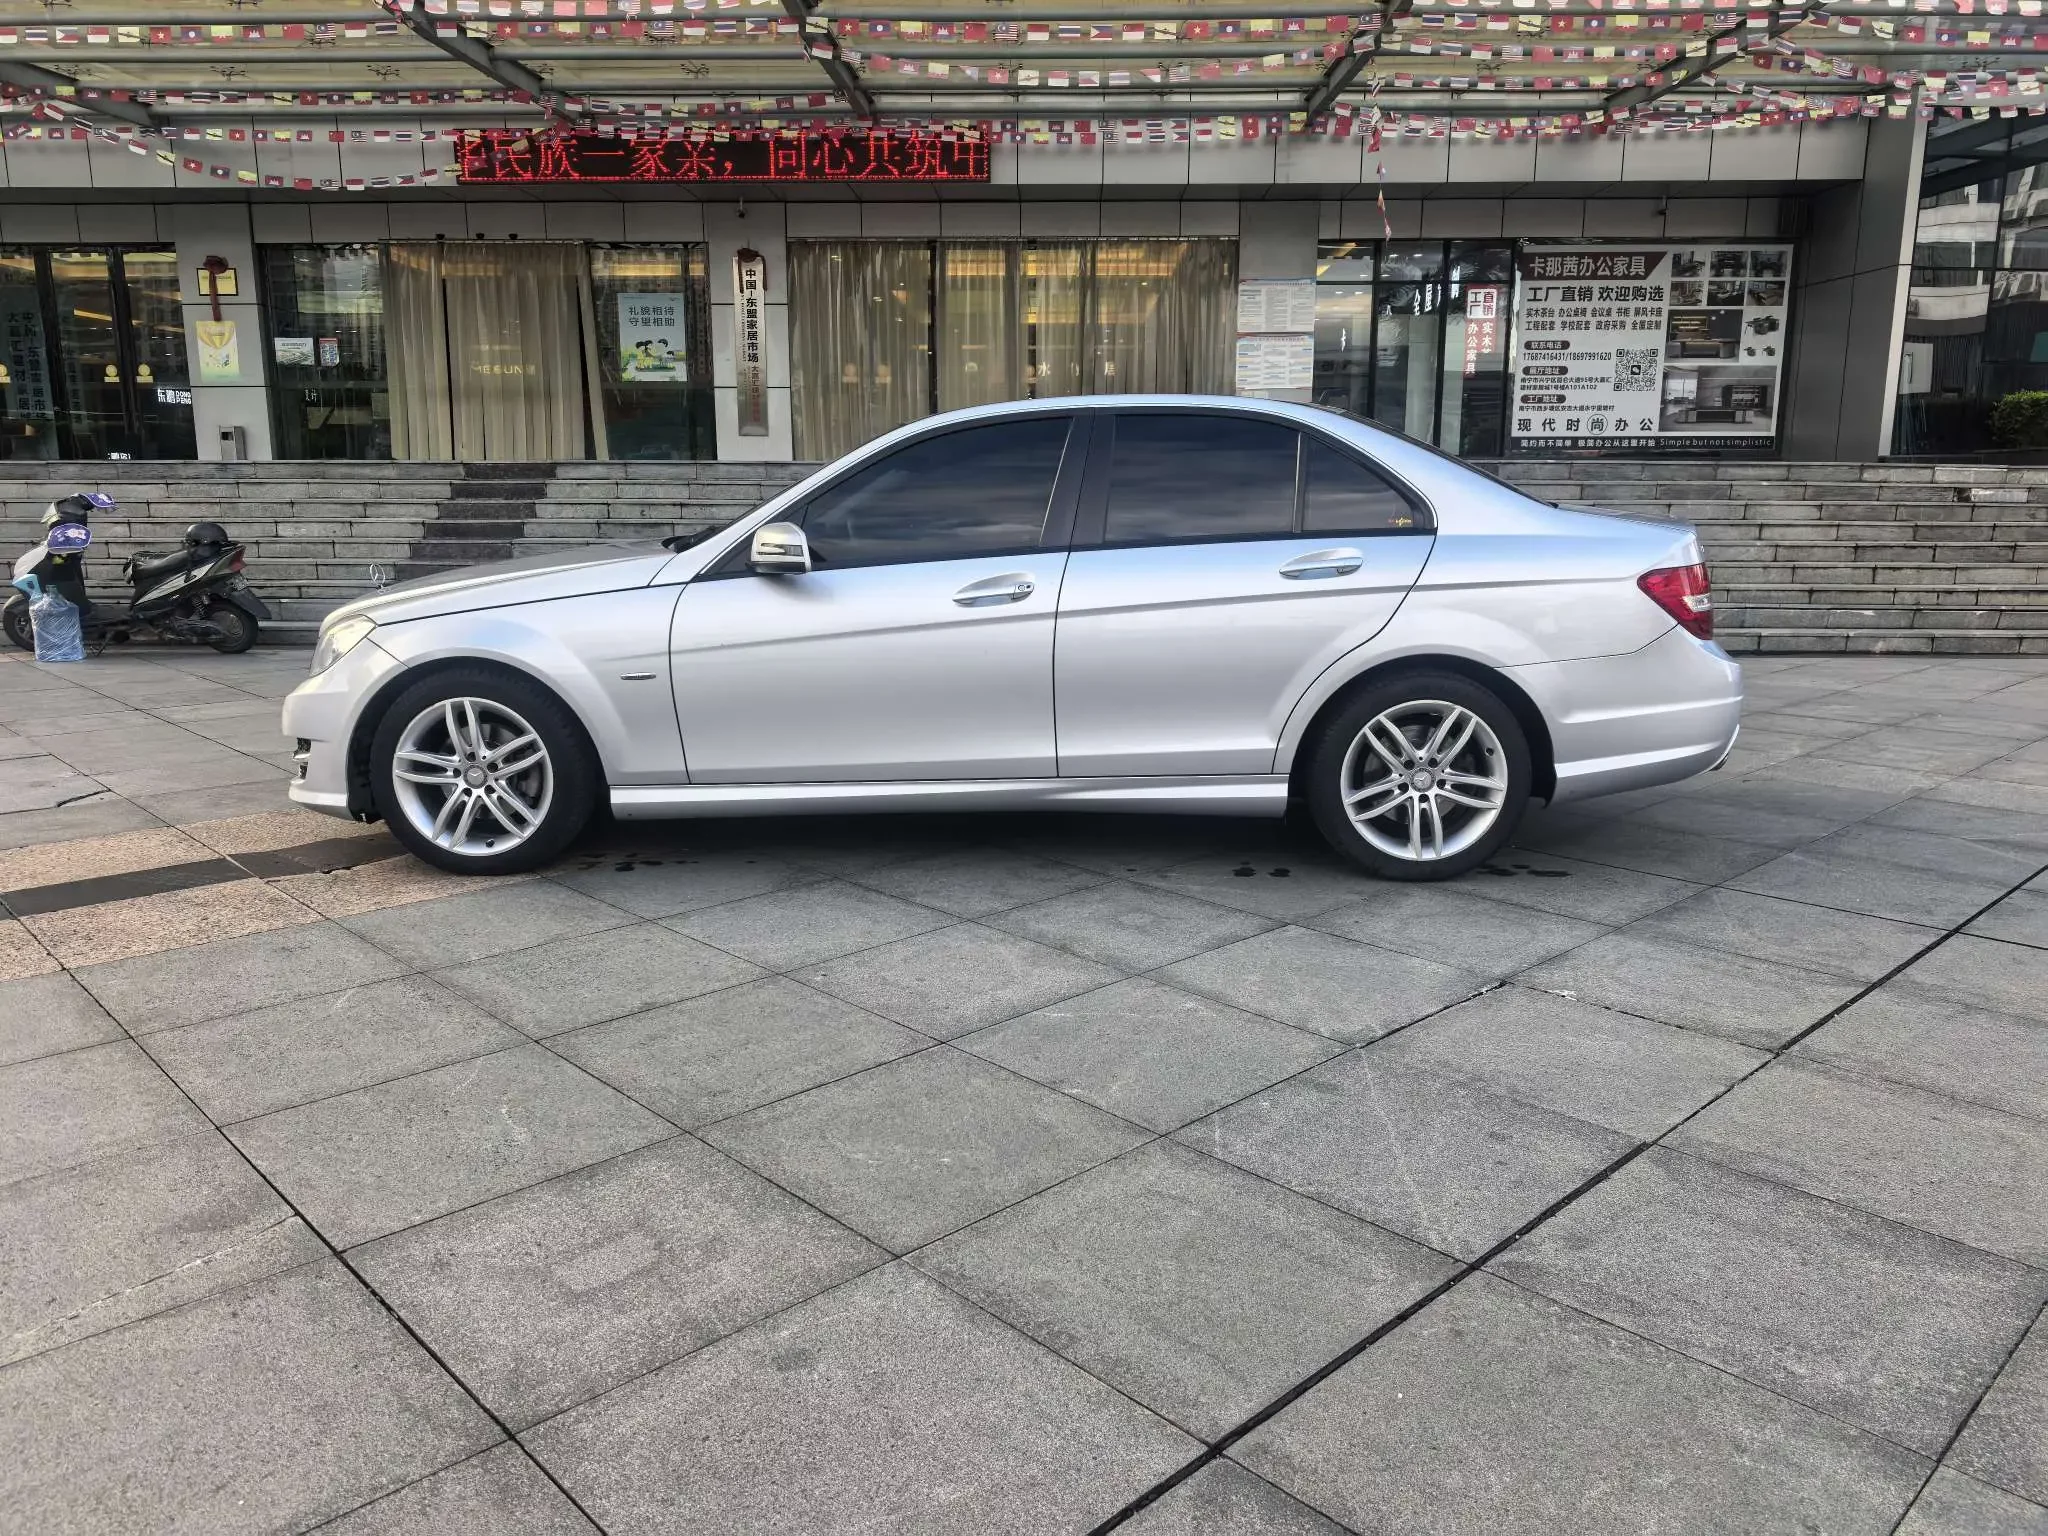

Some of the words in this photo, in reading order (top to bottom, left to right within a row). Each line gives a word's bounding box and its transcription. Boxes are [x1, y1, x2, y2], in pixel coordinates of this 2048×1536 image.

[1529, 255, 1646, 277] 卡那茜办公家具
[1526, 285, 1594, 302] 工厂直销
[1597, 285, 1665, 302] 欢迎购选
[628, 305, 675, 316] 礼貌相待
[1558, 307, 1587, 318] 办公桌椅
[1591, 307, 1612, 318] 会议桌
[628, 317, 675, 327] 守望相助
[1525, 321, 1556, 331] 工程配套
[1560, 321, 1591, 331] 学校配套
[1595, 321, 1627, 331] 政府采购
[1465, 322, 1479, 375] 办公家具
[1517, 418, 1654, 432] 现代时尚办公
[1520, 439, 1572, 448] 简约而不简单
